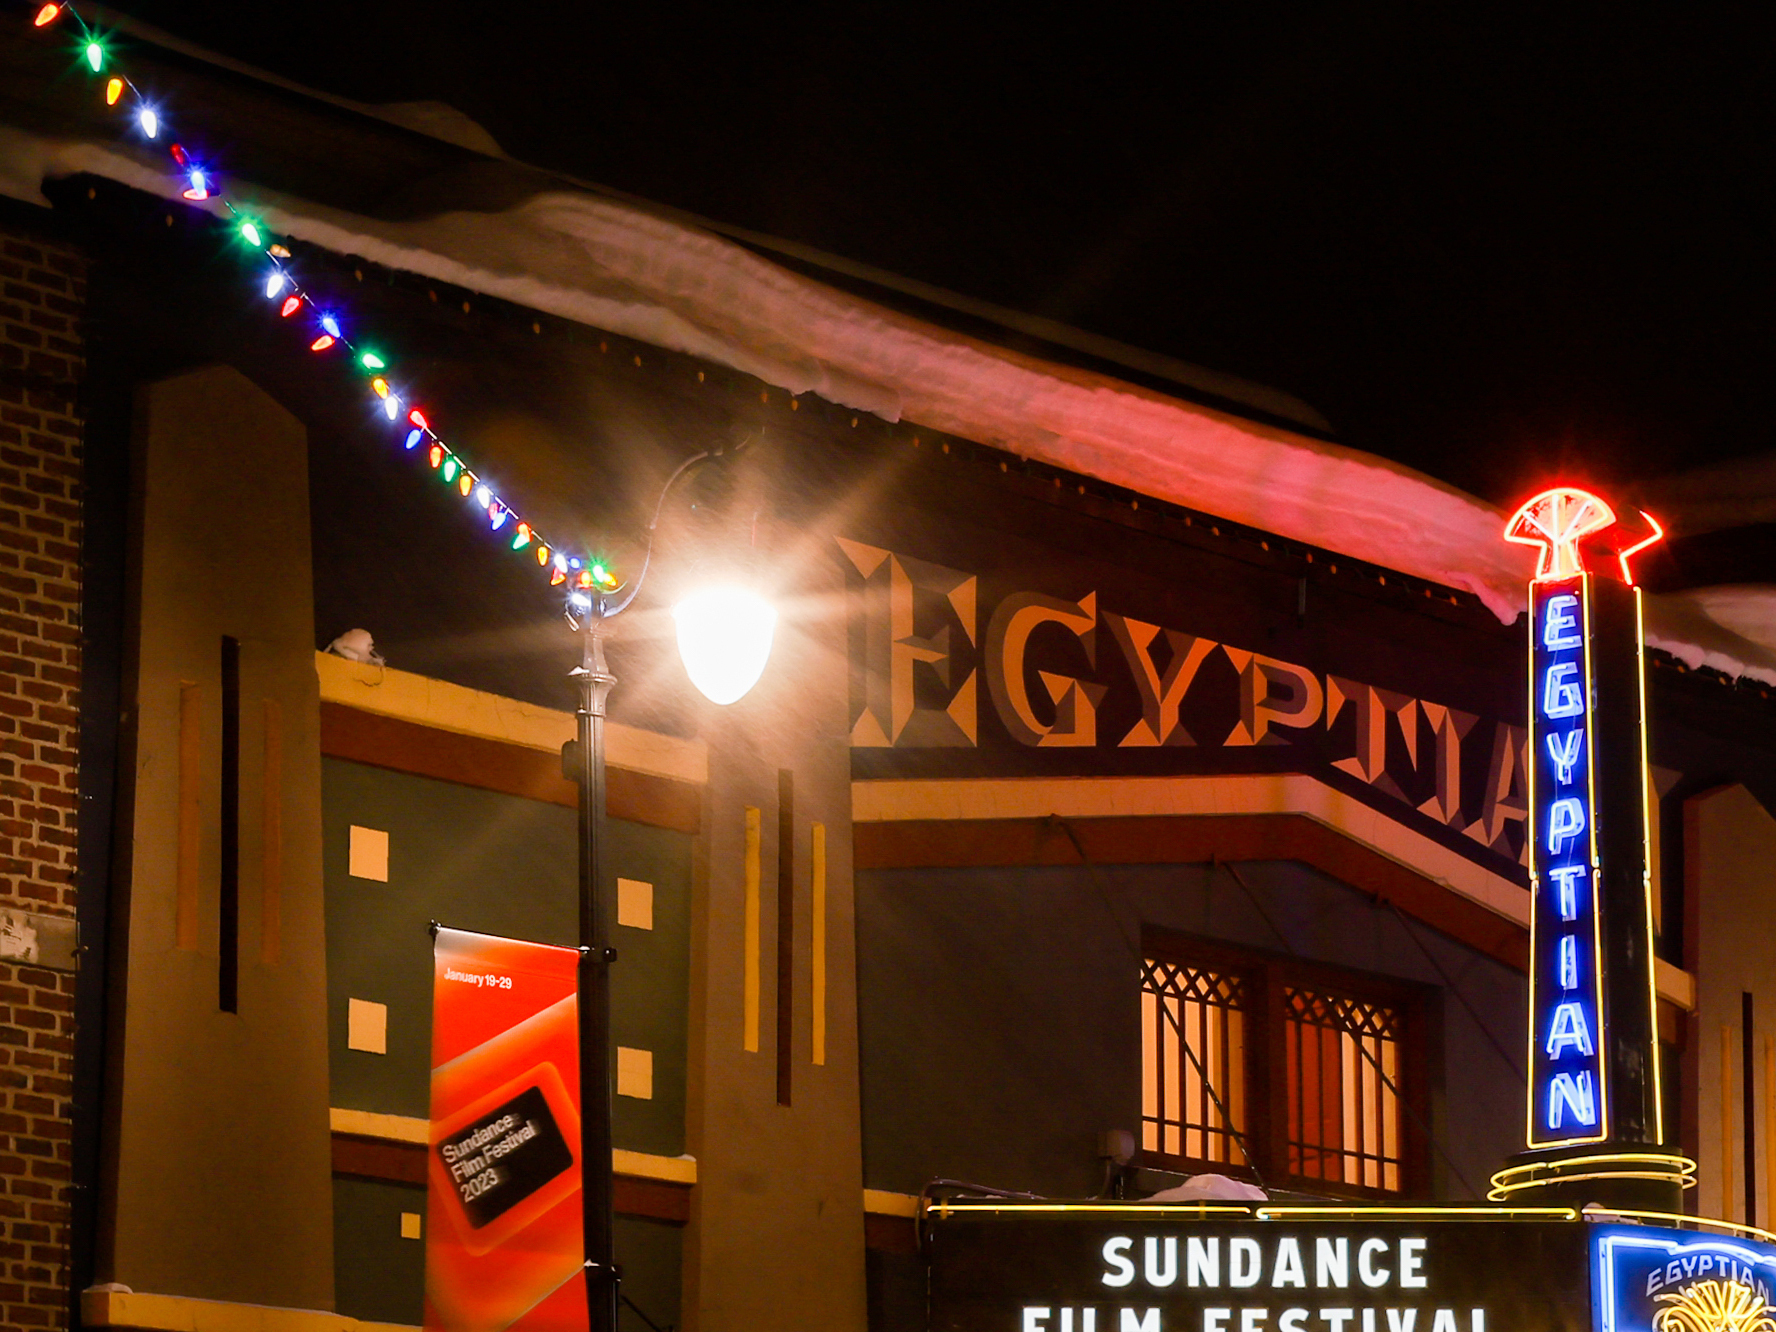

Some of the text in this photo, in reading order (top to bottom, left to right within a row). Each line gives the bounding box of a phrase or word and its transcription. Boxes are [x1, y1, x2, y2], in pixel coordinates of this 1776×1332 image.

[833, 535, 1684, 936] EGYPTIA
[1542, 593, 1594, 1129] EGYPTIAN
[444, 967, 512, 989] January 19-29
[442, 1114, 514, 1163] Sundance
[451, 1120, 536, 1183] Film Festival
[460, 1168, 498, 1203] 2023
[1101, 1235, 1429, 1290] SUNDANCE
[1646, 1254, 1770, 1315] EGYPTIAN
